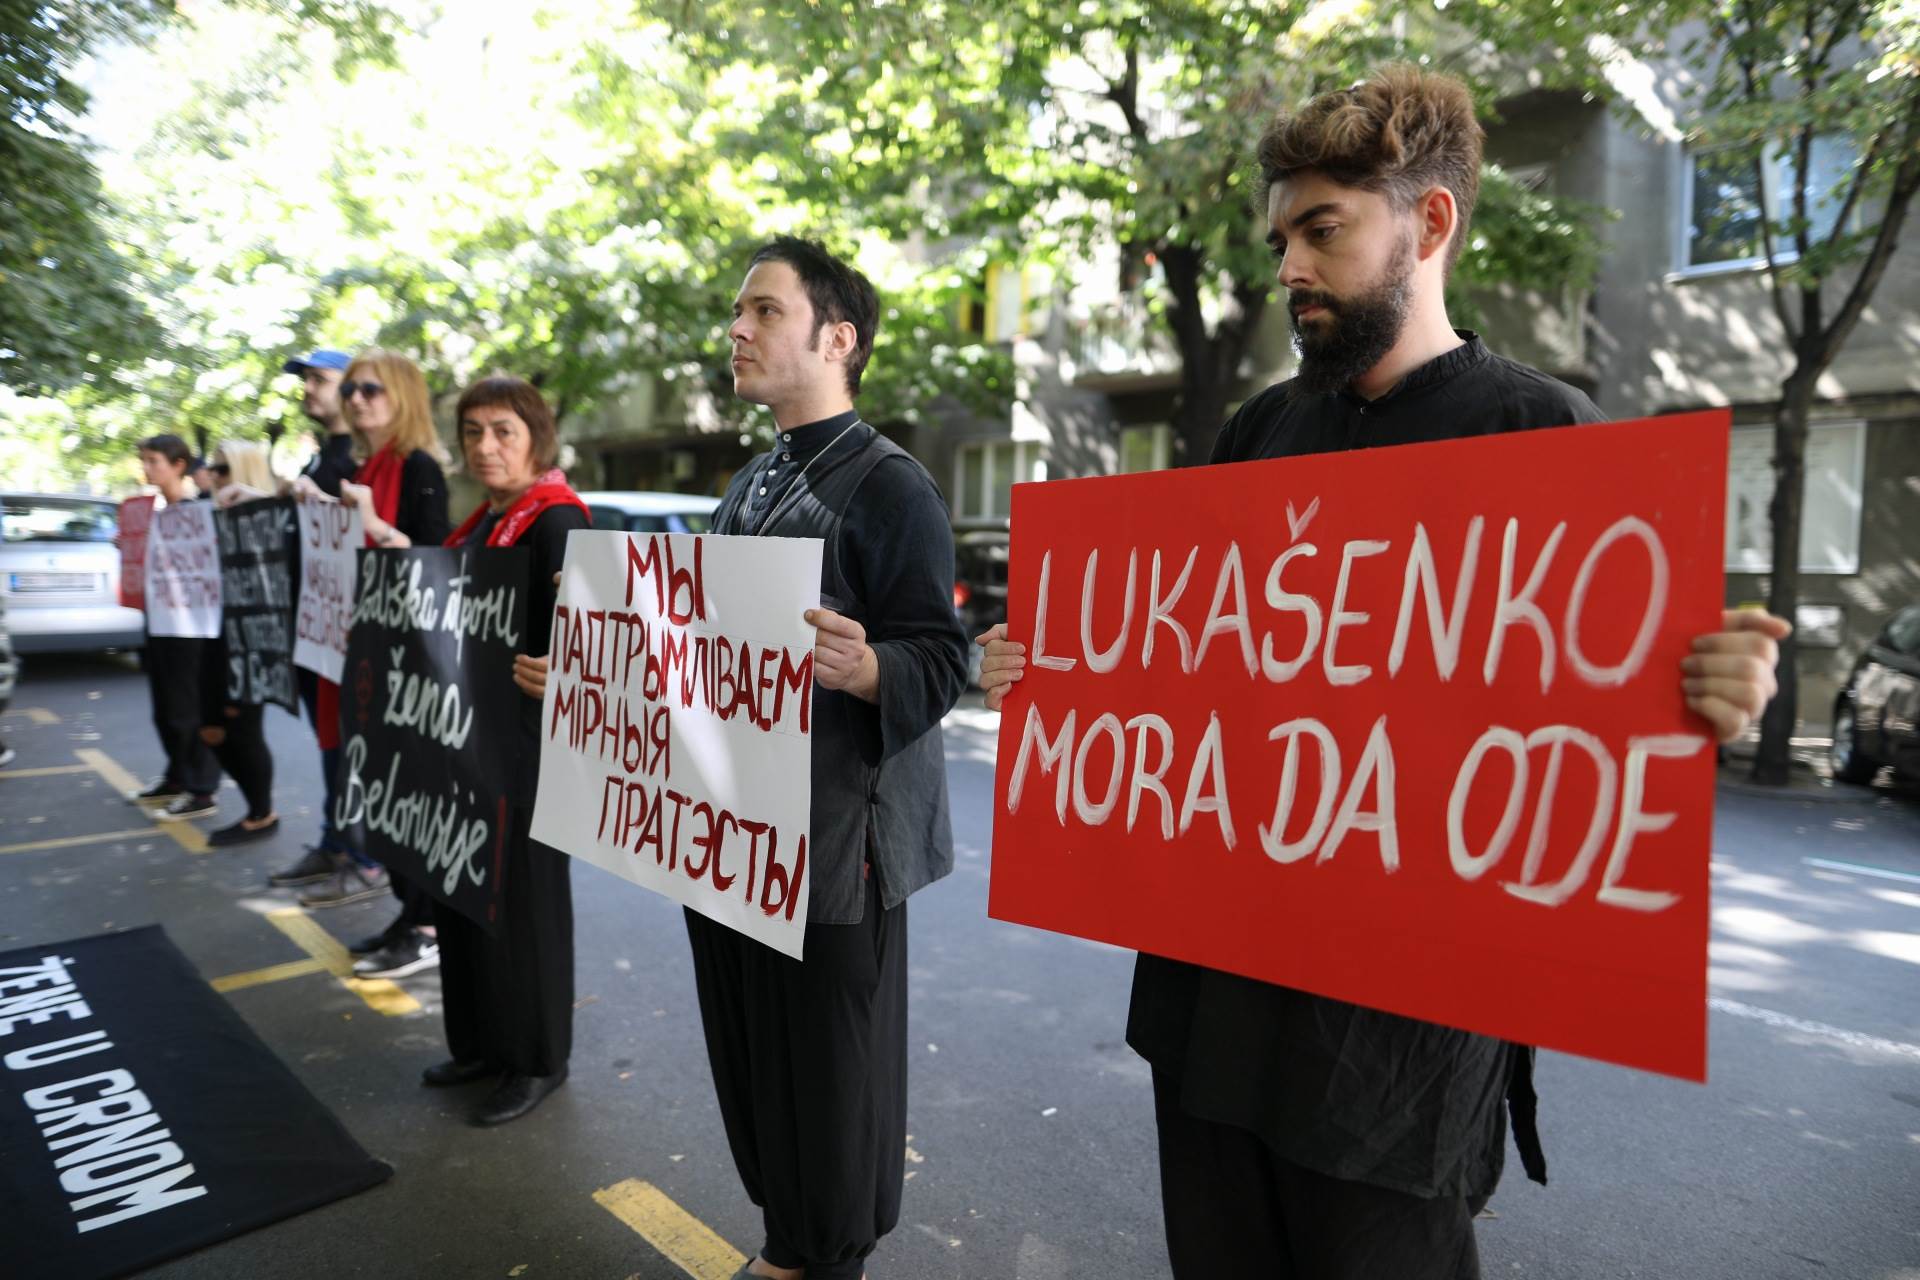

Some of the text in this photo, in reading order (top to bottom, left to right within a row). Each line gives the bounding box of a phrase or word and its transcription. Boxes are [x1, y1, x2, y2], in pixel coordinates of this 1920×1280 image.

[441, 552, 519, 668] otporu
[625, 534, 706, 626] МЫ
[1031, 496, 1670, 694] LUKAŠENKO
[384, 645, 474, 750] žena
[550, 682, 671, 782] МІРНЫЯ
[551, 605, 814, 734] ПАДТРЫМЛІВАЕМ
[335, 734, 488, 896] Belorusije
[598, 776, 806, 922] ПРАТЭСТЫ
[1008, 702, 1709, 911] MORA DA ODE
[4, 1030, 115, 1070] U
[23, 1068, 208, 1234] CRNOM
